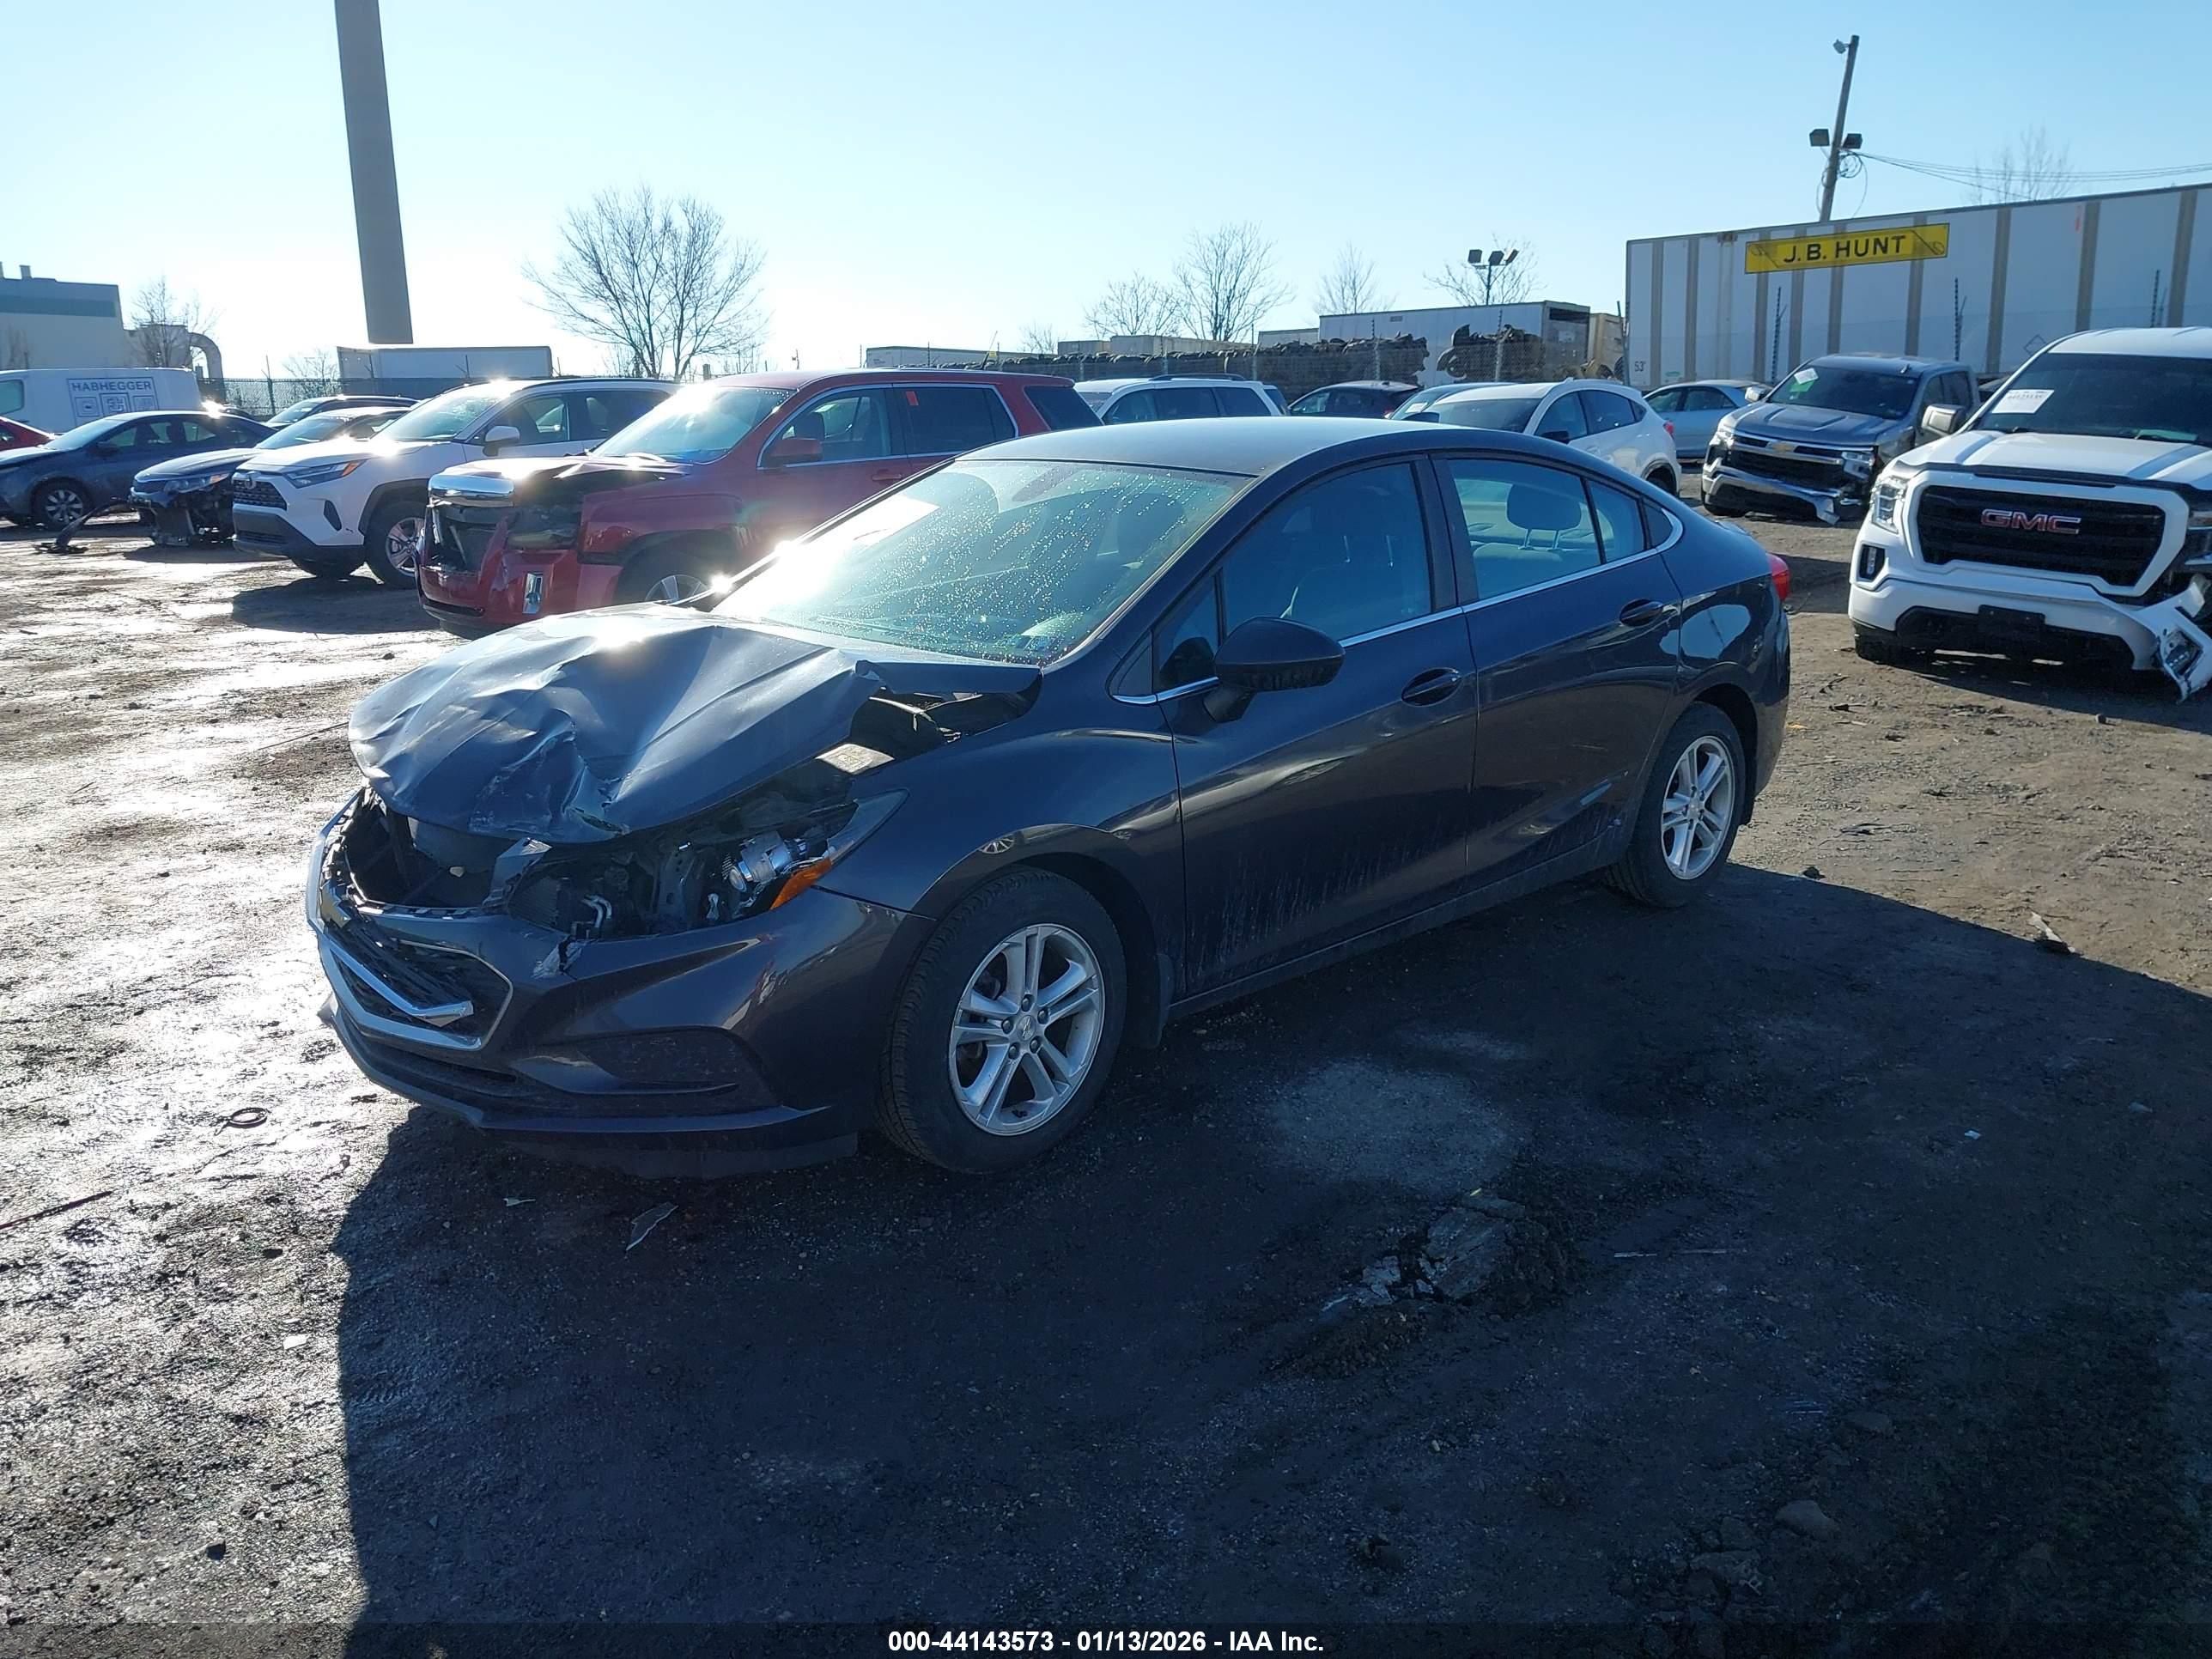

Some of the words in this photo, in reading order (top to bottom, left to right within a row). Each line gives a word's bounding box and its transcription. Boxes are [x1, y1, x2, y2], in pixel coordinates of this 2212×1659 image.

[1835, 234, 1905, 258] HUNT
[71, 380, 152, 392] HABHEGGER
[1981, 508, 2081, 535] GMC
